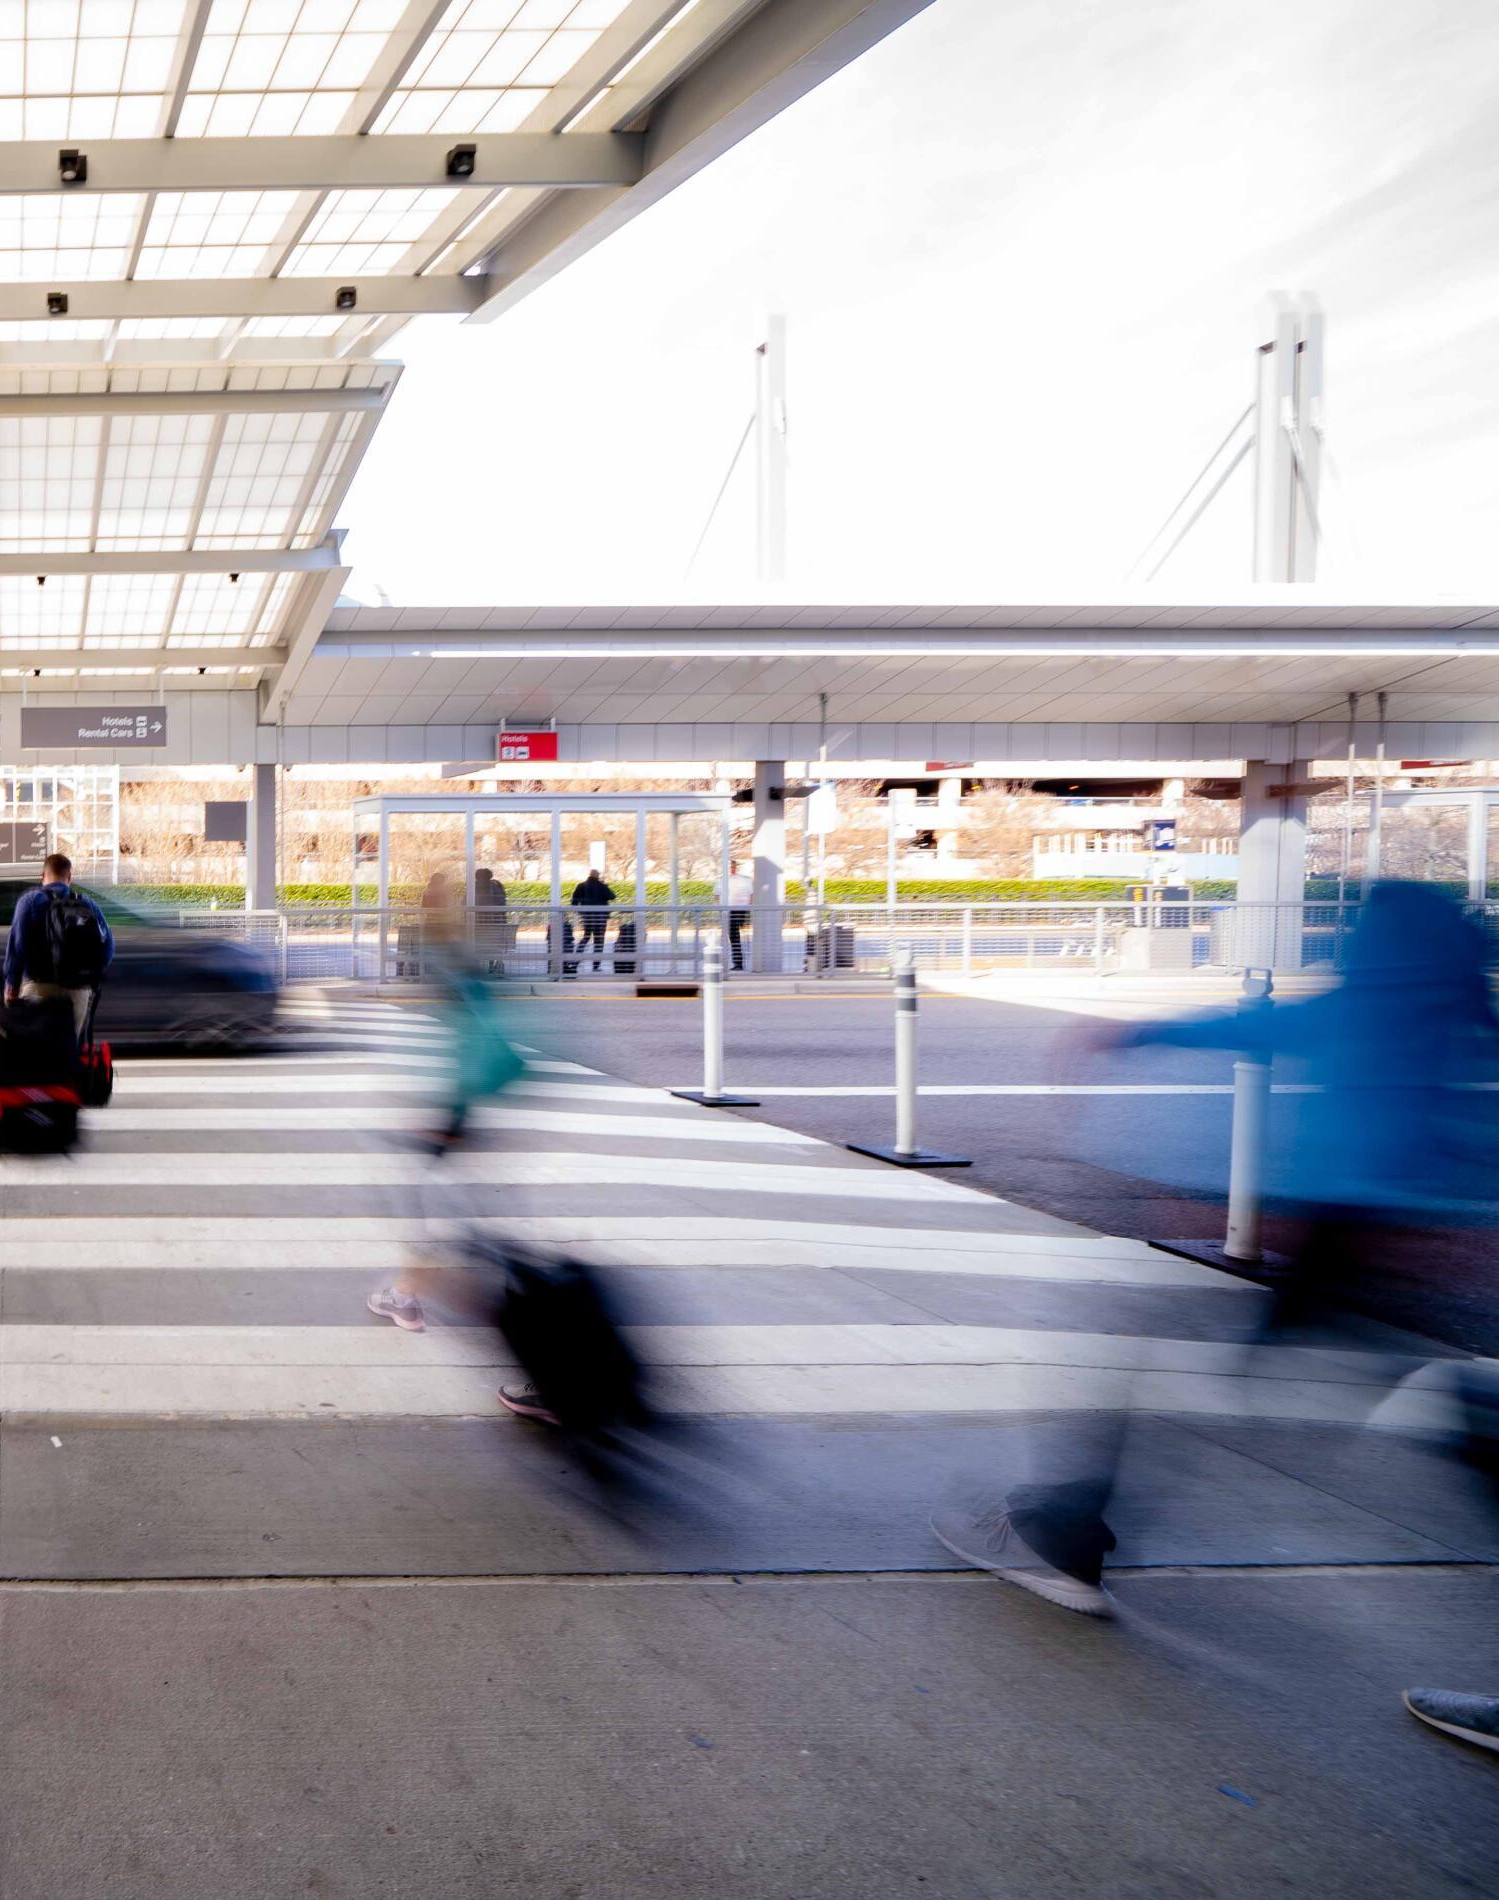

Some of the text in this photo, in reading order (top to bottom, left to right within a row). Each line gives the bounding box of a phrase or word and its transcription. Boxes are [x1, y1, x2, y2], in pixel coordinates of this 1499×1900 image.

[102, 717, 133, 727] Hotels
[78, 728, 133, 738] Rental Cars
